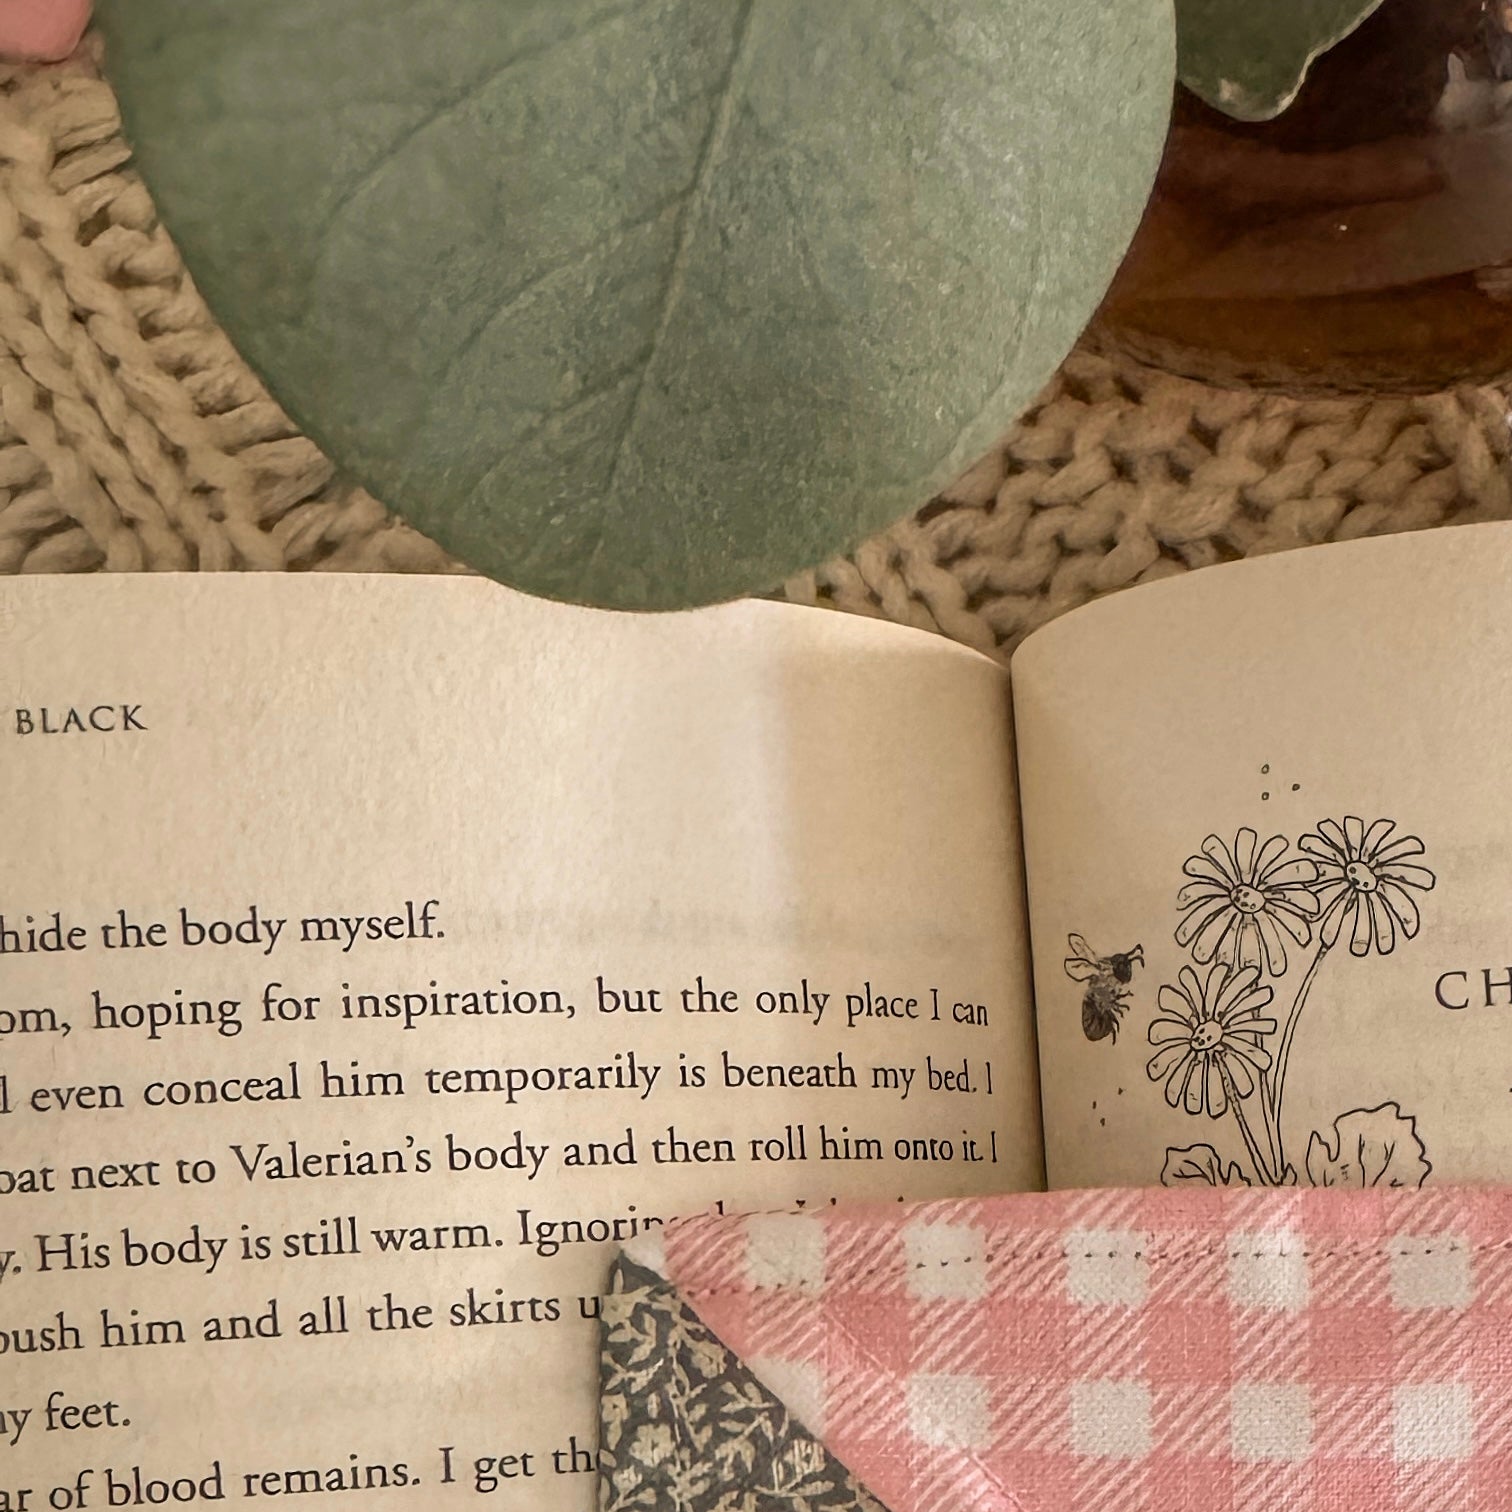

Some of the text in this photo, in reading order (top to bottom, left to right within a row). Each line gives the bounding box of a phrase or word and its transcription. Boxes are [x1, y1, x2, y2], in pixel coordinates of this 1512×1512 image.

[16, 705, 148, 734] BLACK
[101, 910, 167, 948] the
[179, 905, 287, 955] body
[301, 900, 444, 952] myself.
[91, 976, 988, 1039] hoping for inspiration, but the only place I can
[30, 1051, 977, 1112] even conceal him temporarily is beneath my bed.
[101, 1288, 560, 1347] him and all the skirts
[45, 1392, 130, 1431] feet.
[49, 1447, 535, 1510] of blood remains. I get
